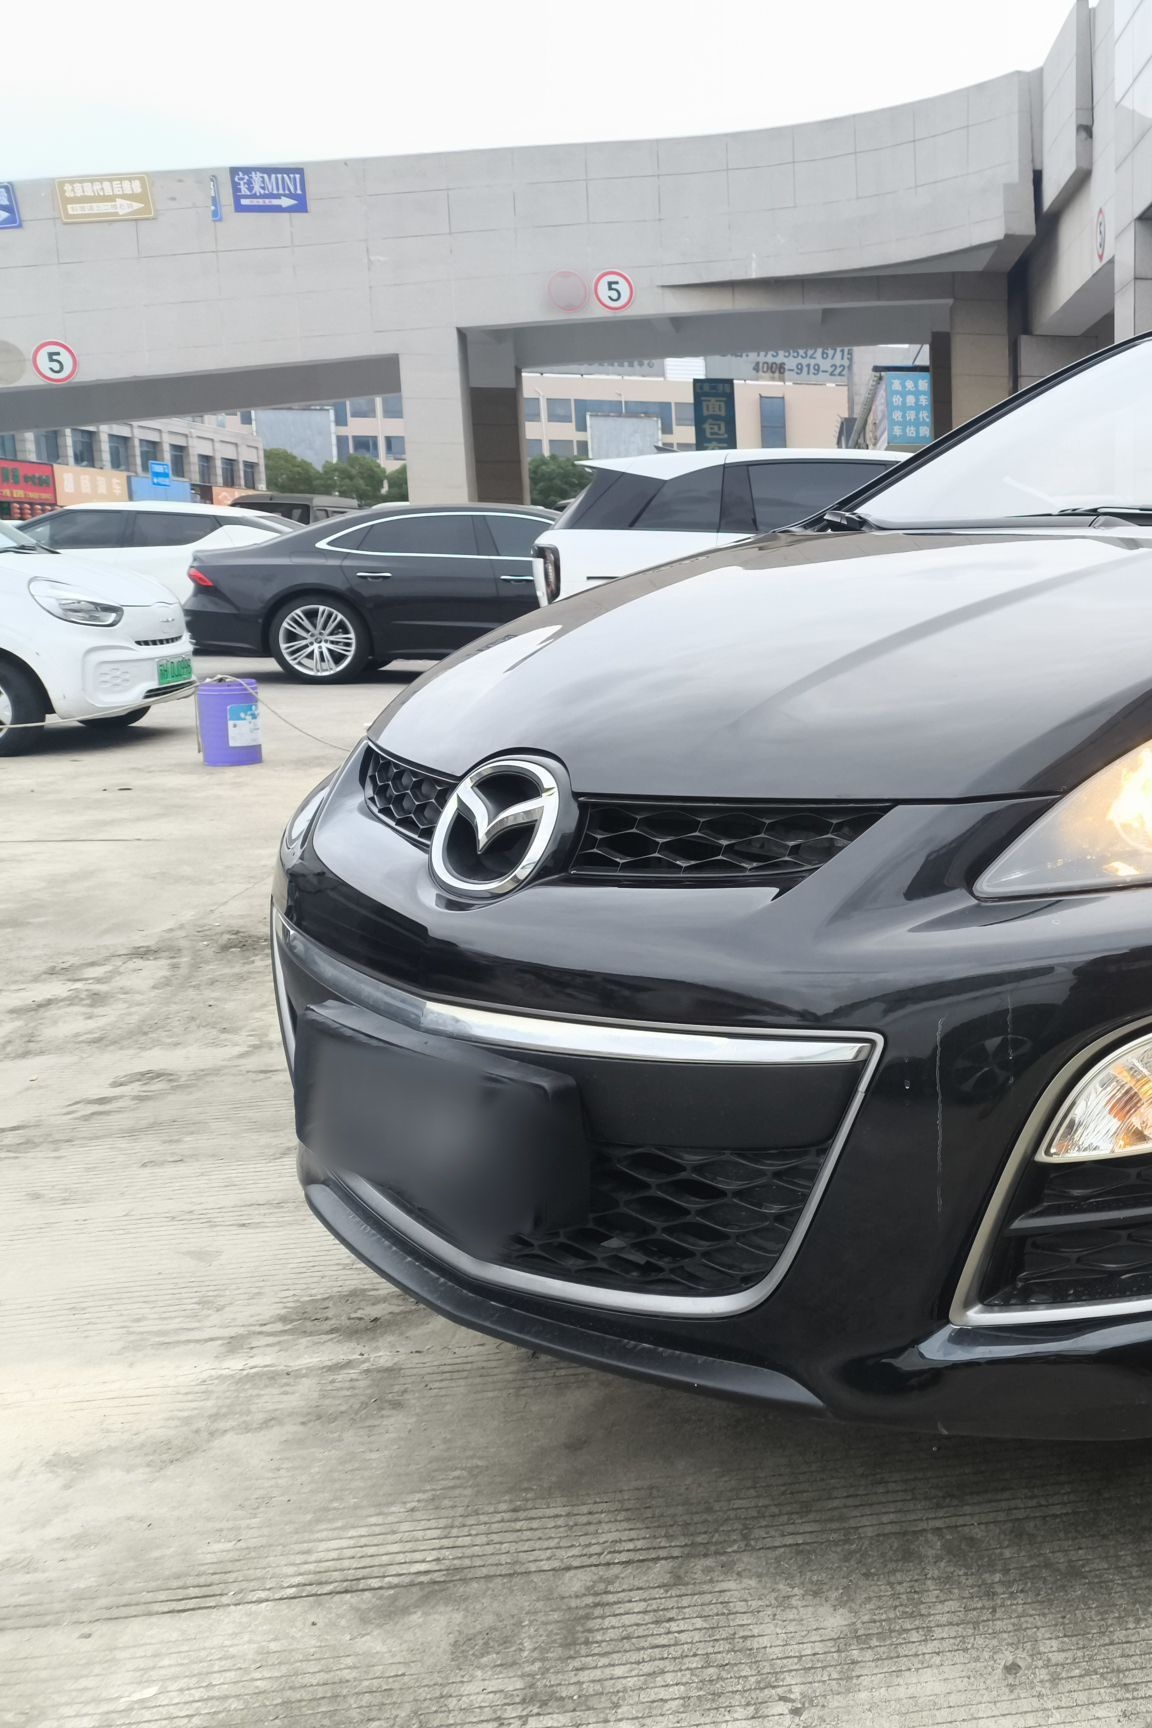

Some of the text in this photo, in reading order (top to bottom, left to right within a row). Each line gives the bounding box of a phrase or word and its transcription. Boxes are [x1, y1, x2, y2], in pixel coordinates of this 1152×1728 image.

[607, 281, 621, 302] 5
[47, 351, 64, 374] 5
[752, 361, 851, 377] 4006-919-22
